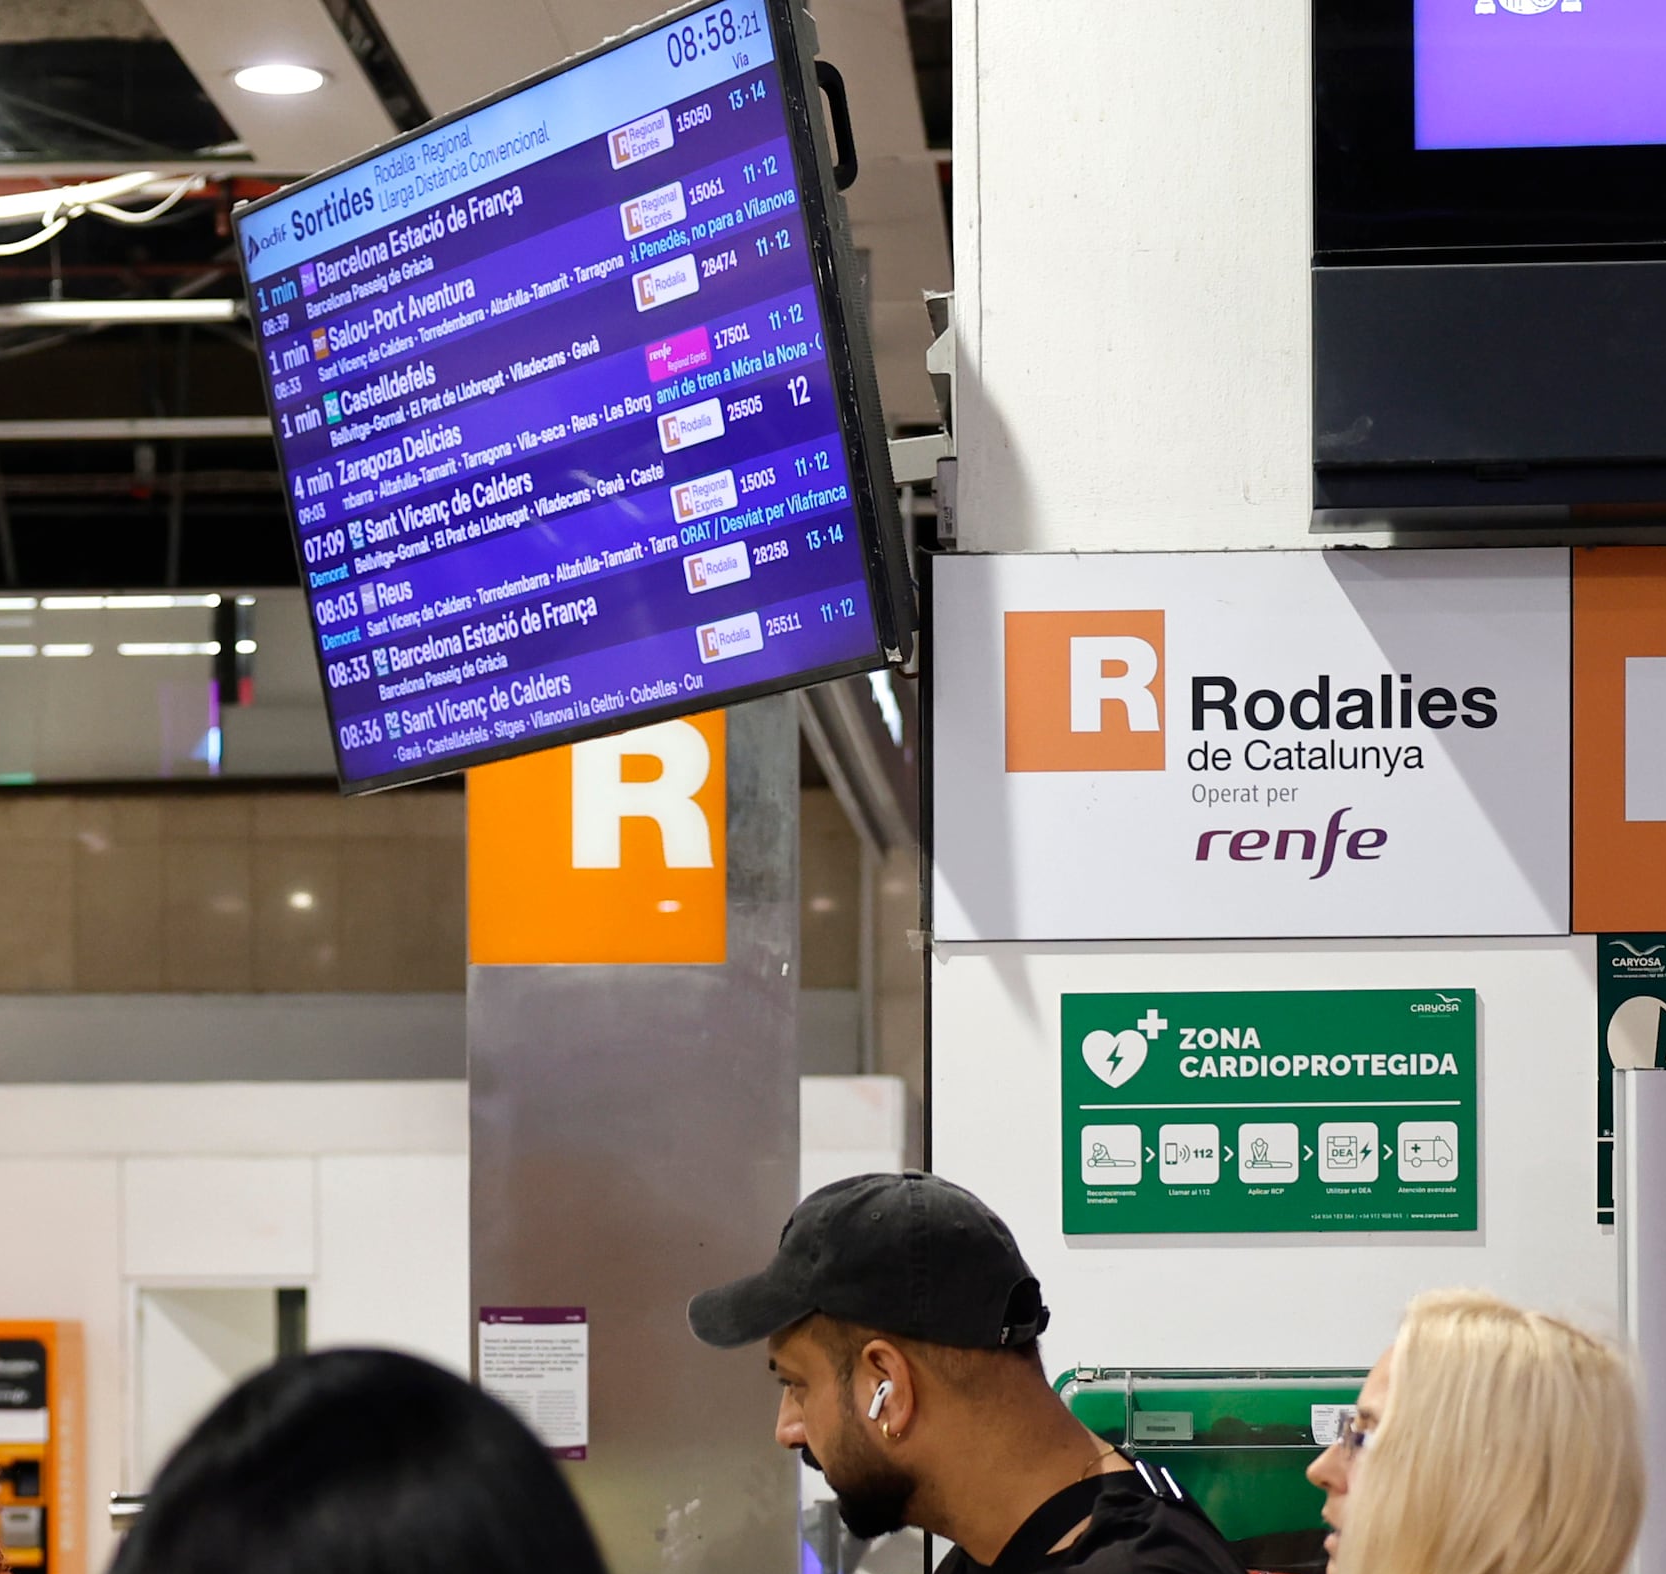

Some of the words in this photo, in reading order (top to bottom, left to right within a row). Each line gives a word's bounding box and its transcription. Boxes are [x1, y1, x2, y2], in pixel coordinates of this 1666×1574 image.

[373, 152, 415, 185] Rodalia
[421, 123, 472, 164] Regional
[378, 184, 414, 212] Llarga
[414, 158, 468, 196] Distància
[468, 120, 549, 172] Convencional
[256, 287, 269, 312] 1
[270, 276, 297, 306] min
[315, 242, 388, 287] Barcelona
[388, 210, 444, 256] Estació
[446, 204, 467, 232] de
[467, 185, 522, 224] França
[676, 103, 711, 132] 15050
[260, 223, 286, 249] adif
[291, 187, 373, 241] Sortides
[268, 350, 281, 375] 1
[282, 340, 309, 370] min
[328, 301, 406, 350] Salou-Port
[408, 278, 475, 321] Aventura
[688, 177, 724, 205] 15061
[280, 413, 293, 438] 1
[294, 404, 321, 433] min
[340, 360, 435, 414] Castelldefels
[654, 271, 686, 291] Rodalia
[701, 249, 737, 277] 28474
[409, 399, 422, 418] El
[420, 393, 442, 414] Prat
[442, 388, 456, 406] de
[455, 370, 505, 401] Llobregat
[508, 351, 566, 381] Viladecans
[571, 334, 599, 359] Gavà
[294, 475, 304, 499] 4
[306, 467, 333, 496] min
[336, 447, 403, 485] Zaragoza
[402, 424, 461, 461] Delicias
[714, 322, 750, 349] 17501
[304, 529, 344, 562] 07:09
[364, 512, 399, 543] Sant
[397, 500, 449, 531] Vicenç
[451, 488, 471, 515] de
[472, 472, 533, 507] Calders
[726, 394, 762, 421] 25505
[787, 375, 810, 406] 12
[309, 562, 349, 588] Demorat
[316, 591, 358, 625] 08:03
[376, 581, 412, 607] Reus
[739, 467, 775, 493] 15003
[328, 654, 370, 687] 08:33
[388, 634, 462, 671] Barcelona
[462, 610, 518, 650] Estació
[520, 607, 541, 634] de
[541, 596, 597, 628] França
[752, 540, 788, 564] 28258
[340, 718, 382, 749] 08:36
[401, 705, 436, 734] Sant
[435, 696, 487, 725] Vicenç
[489, 685, 509, 712] de
[510, 673, 571, 705] Calders
[765, 612, 801, 636] 25511
[1070, 636, 1160, 733] R
[1191, 674, 1499, 731] Rodalies
[1187, 741, 1232, 772] de
[1244, 740, 1424, 777] Catalunya
[572, 721, 714, 869] R
[1192, 784, 1259, 808] Operat
[1267, 784, 1299, 808] per
[1195, 807, 1388, 880] renfe
[1612, 957, 1662, 967] CARYOSA
[1410, 1003, 1459, 1013] CARYOSA
[1179, 1027, 1261, 1050] ZONA
[1179, 1052, 1459, 1078] CARDIOPROTEGIDA
[1192, 1148, 1214, 1160] 112
[1331, 1147, 1354, 1159] DEA
[1248, 1188, 1269, 1196] Aplicar
[1427, 1186, 1456, 1194] avanzada
